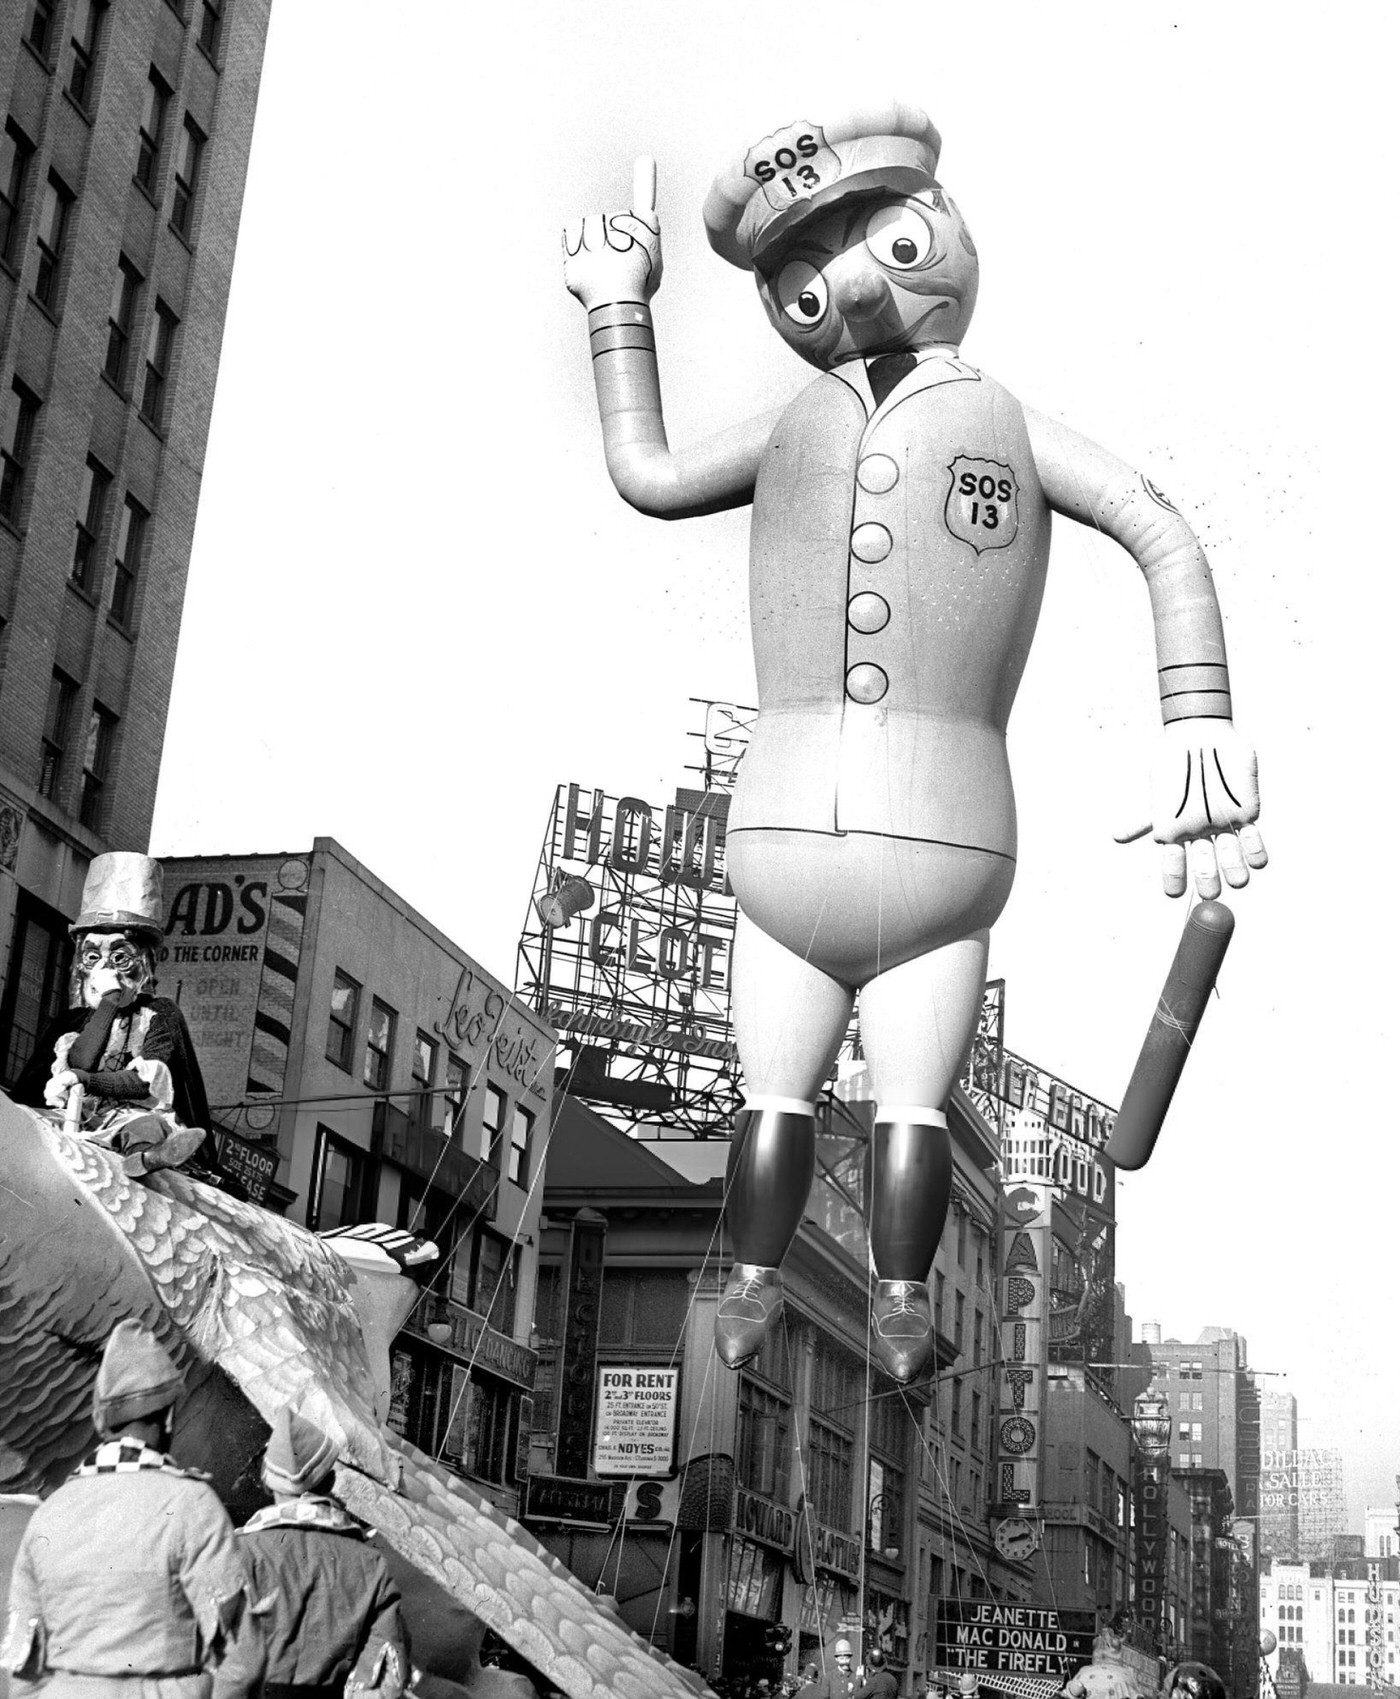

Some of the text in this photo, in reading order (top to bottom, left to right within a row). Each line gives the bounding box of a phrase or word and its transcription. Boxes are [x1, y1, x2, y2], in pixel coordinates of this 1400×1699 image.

[754, 134, 819, 182] SOS
[781, 165, 821, 197] 13
[958, 472, 1013, 502] SOS
[971, 502, 999, 529] 13
[561, 782, 735, 896] HOW
[174, 946, 198, 962] THE
[203, 945, 259, 962] CORNER
[599, 1008, 673, 1055] Style
[239, 1146, 274, 1176] FLOOR
[603, 1373, 675, 1388] FOR RENT
[623, 1402, 645, 1410] ENTRANCE
[634, 1391, 672, 1400] FLOORS
[613, 1410, 638, 1418] BROADWAY
[641, 1410, 667, 1418] ENTRANCE
[618, 1443, 655, 1455] NOYES
[1260, 1450, 1336, 1469] DILLAC
[1270, 1472, 1322, 1489] SALLE
[1288, 1492, 1328, 1507] CARS
[736, 1491, 792, 1548] HOWARD
[1141, 1467, 1159, 1629] HOLLYWOOD
[1217, 1540, 1240, 1551] HOTEL
[970, 1605, 1058, 1629] JEANETTE
[1367, 1563, 1384, 1690] HUDSON
[956, 1625, 1080, 1652] MAC DONALD IN
[946, 1648, 1077, 1674] "THE FIREFLY"
